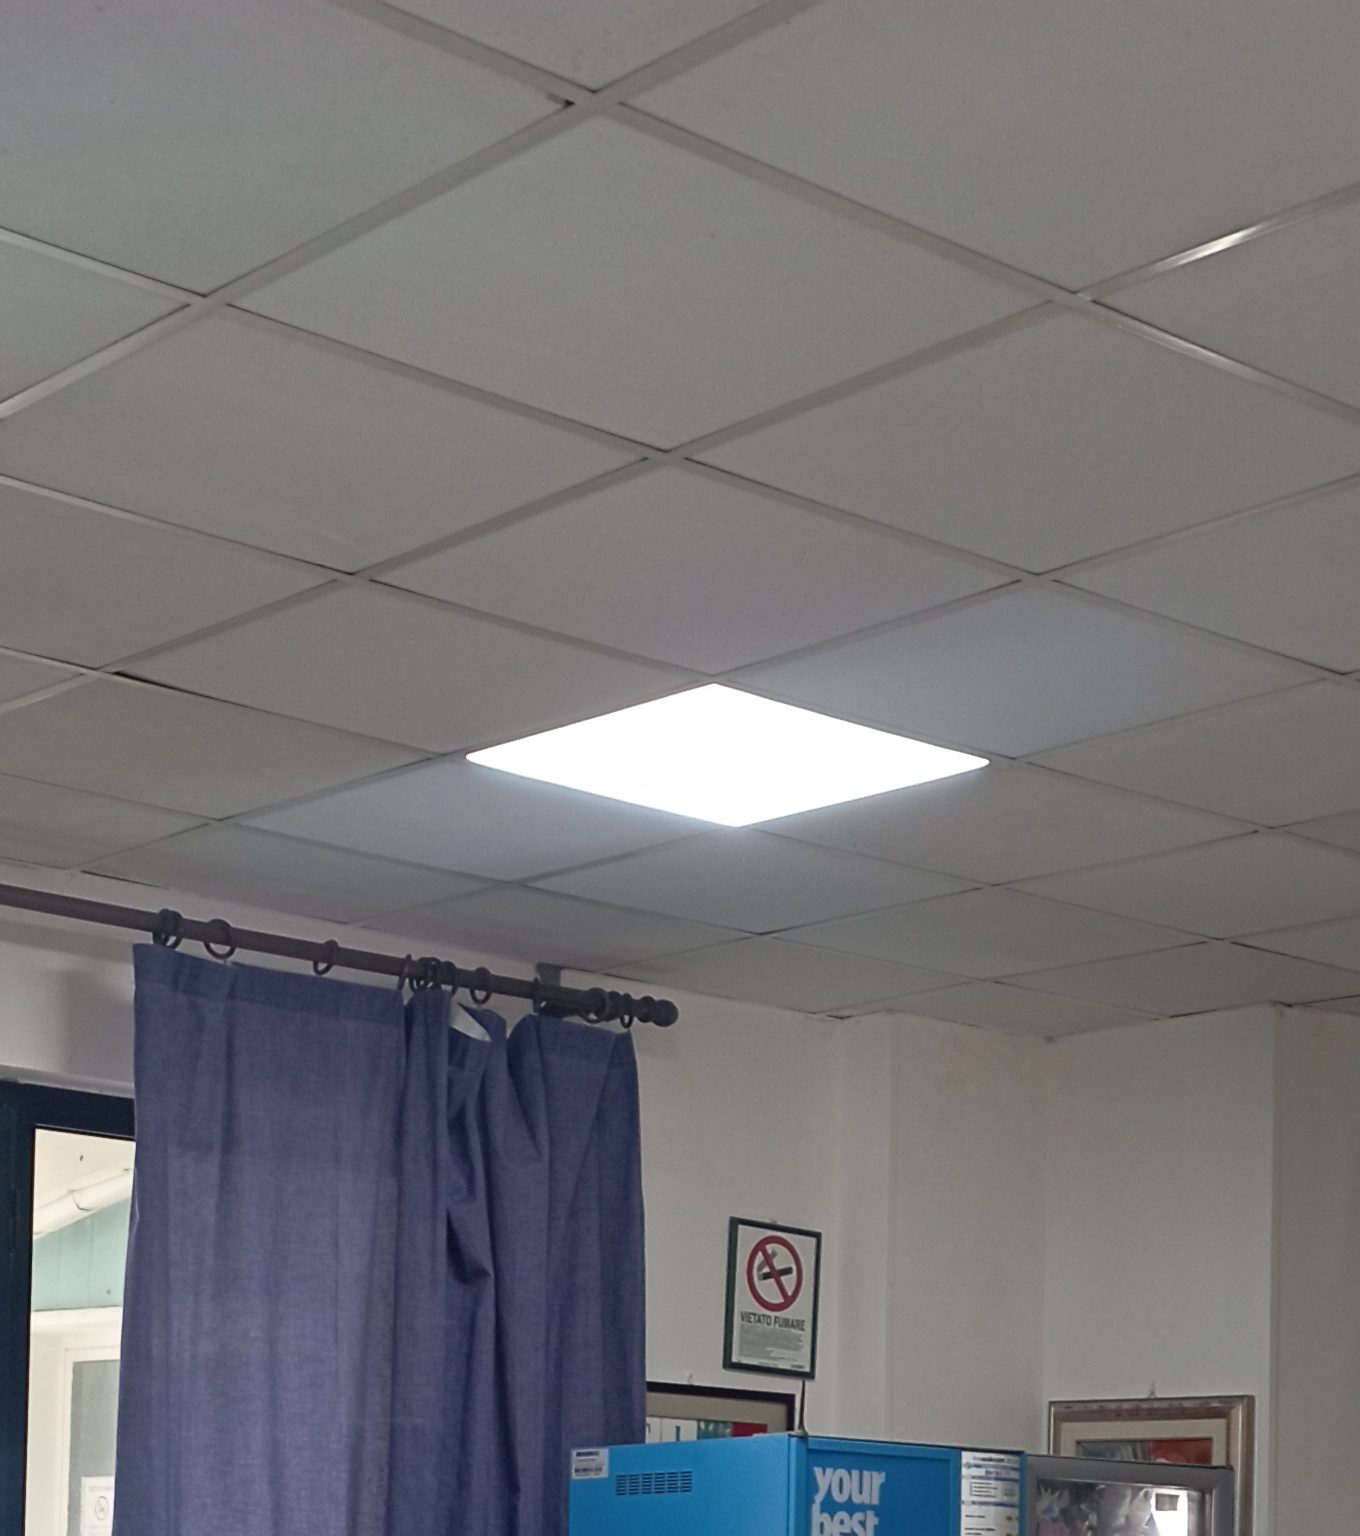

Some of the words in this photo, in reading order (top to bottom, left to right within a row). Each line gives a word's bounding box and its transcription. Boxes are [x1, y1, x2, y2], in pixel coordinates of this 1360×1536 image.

[741, 1311, 772, 1326] VIETATO
[774, 1316, 806, 1331] FUMARE
[814, 1467, 886, 1506] your
